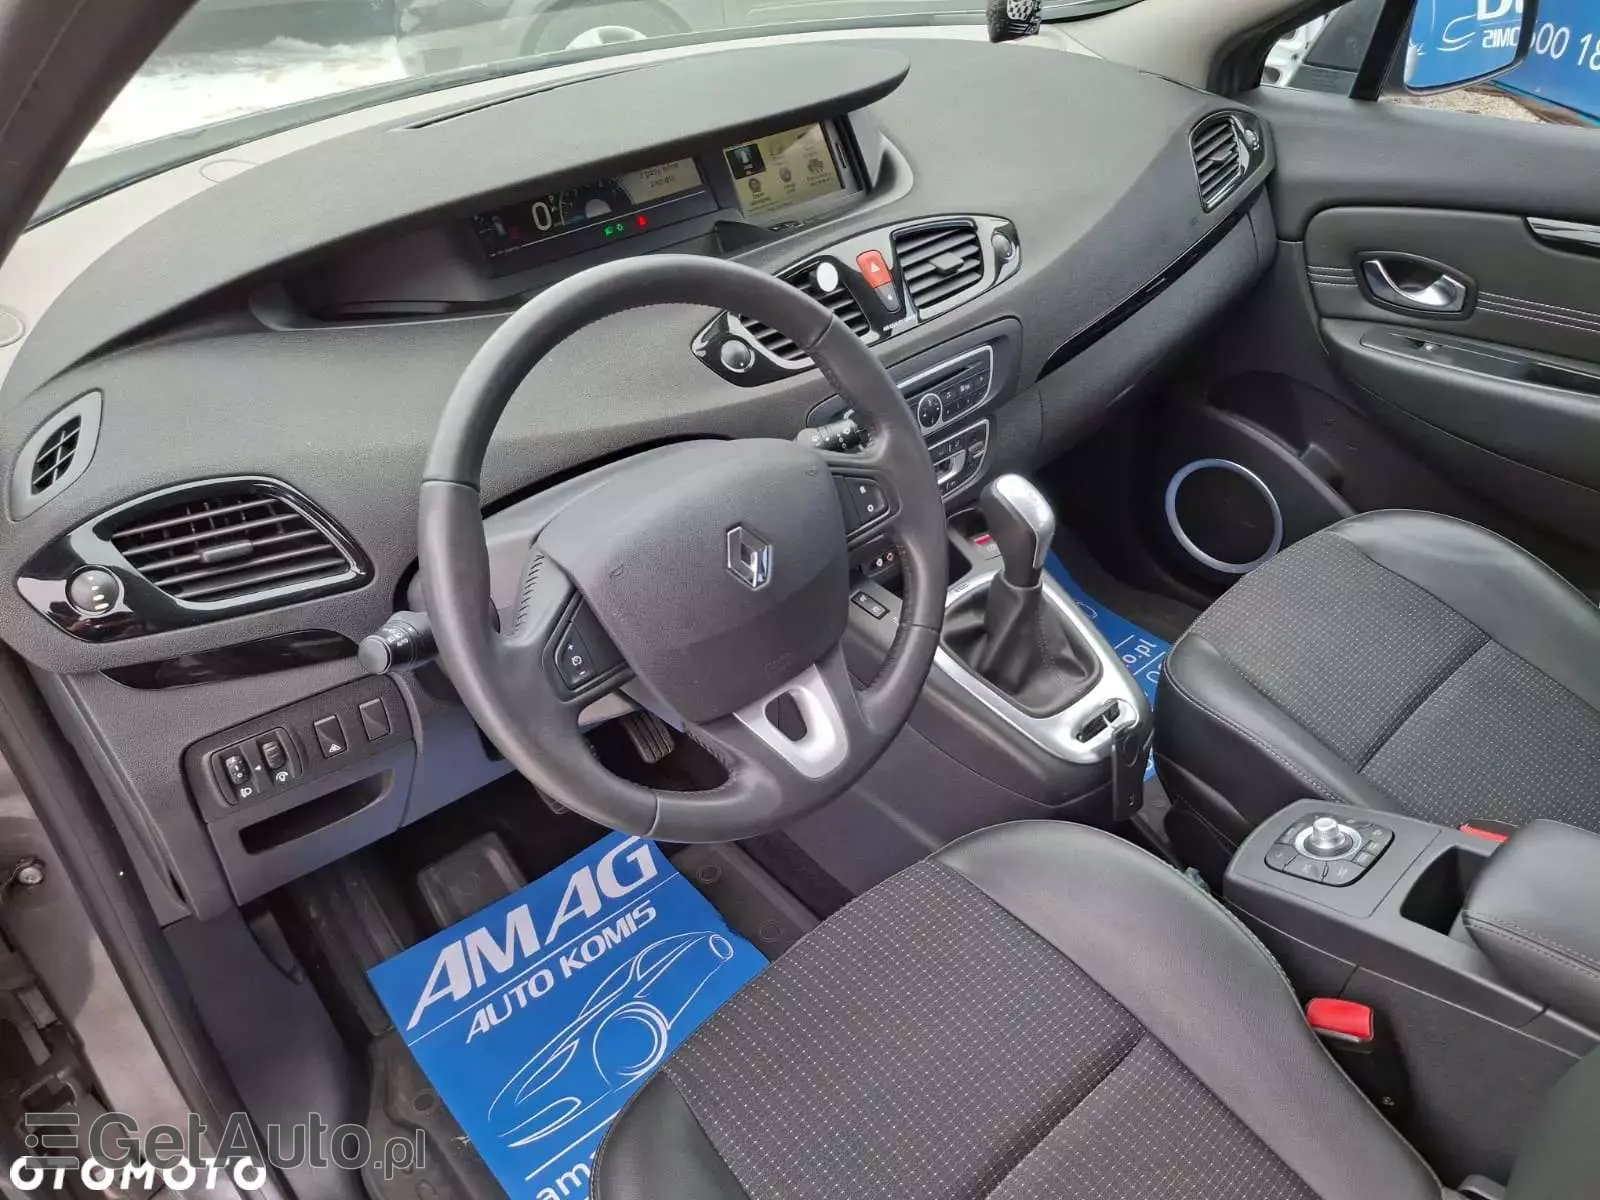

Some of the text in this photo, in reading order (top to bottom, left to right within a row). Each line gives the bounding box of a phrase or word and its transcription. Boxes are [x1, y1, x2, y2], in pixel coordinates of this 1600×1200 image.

[1530, 22, 1570, 60] 00
[531, 201, 553, 231] 0
[1122, 638, 1157, 667] o.pl
[406, 835, 659, 1032] AMAG
[466, 899, 657, 1045] AUTO KOMIS
[535, 1152, 596, 1200] am
